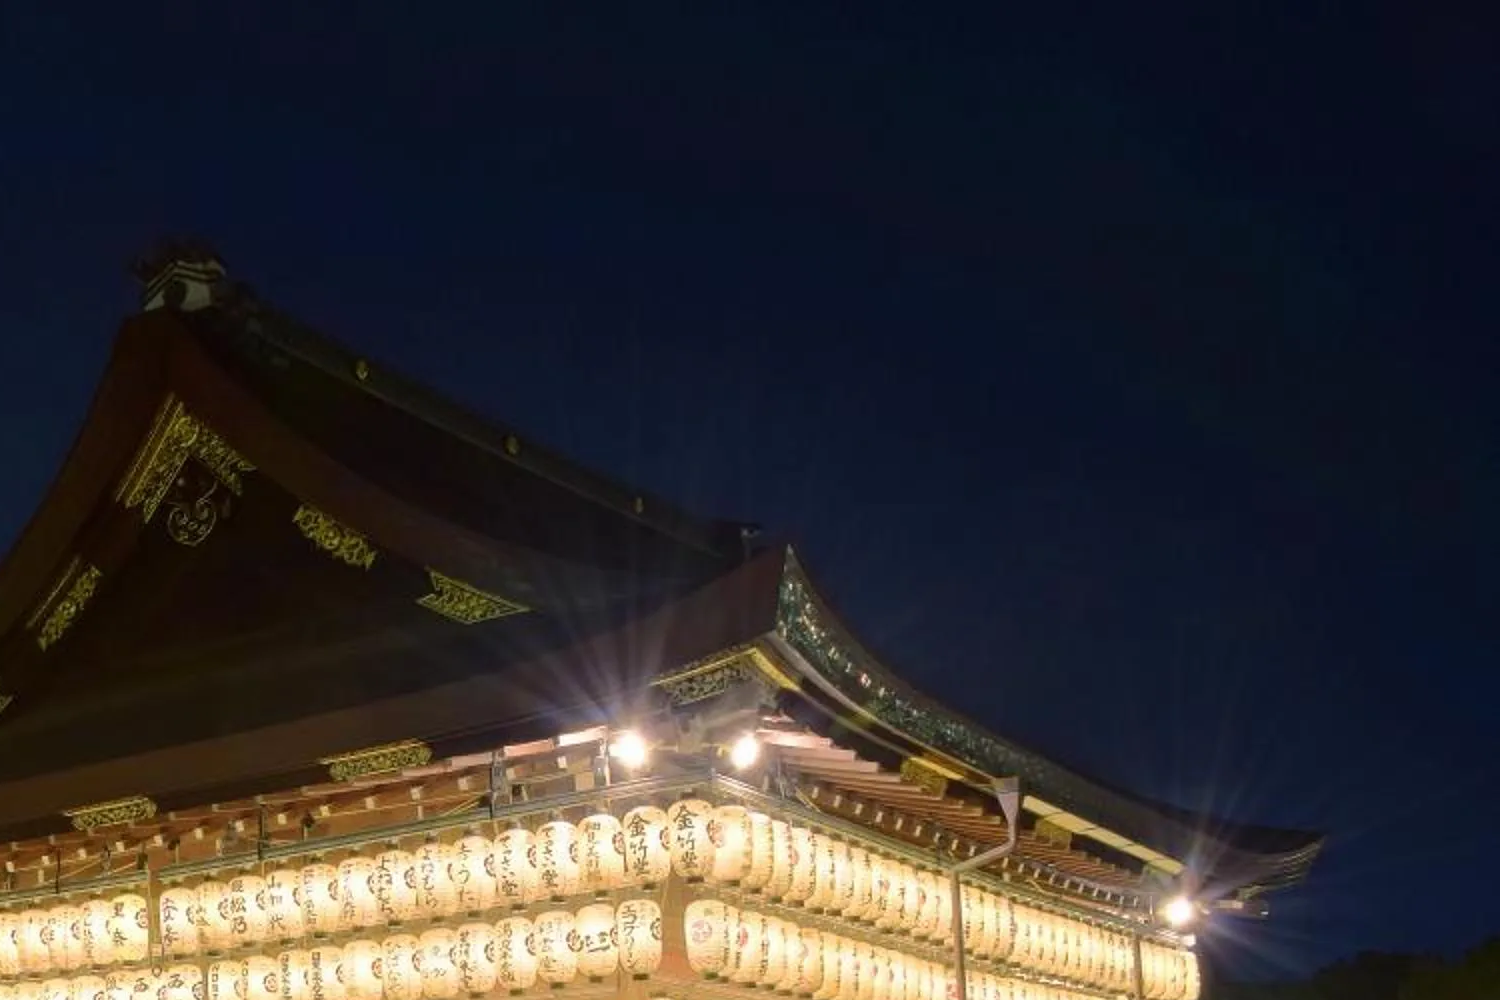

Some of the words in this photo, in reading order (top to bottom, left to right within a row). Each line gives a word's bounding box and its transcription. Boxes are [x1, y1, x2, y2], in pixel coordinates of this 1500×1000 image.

[626, 813, 651, 877] 金竹堂
[672, 804, 698, 870] 金竹堂
